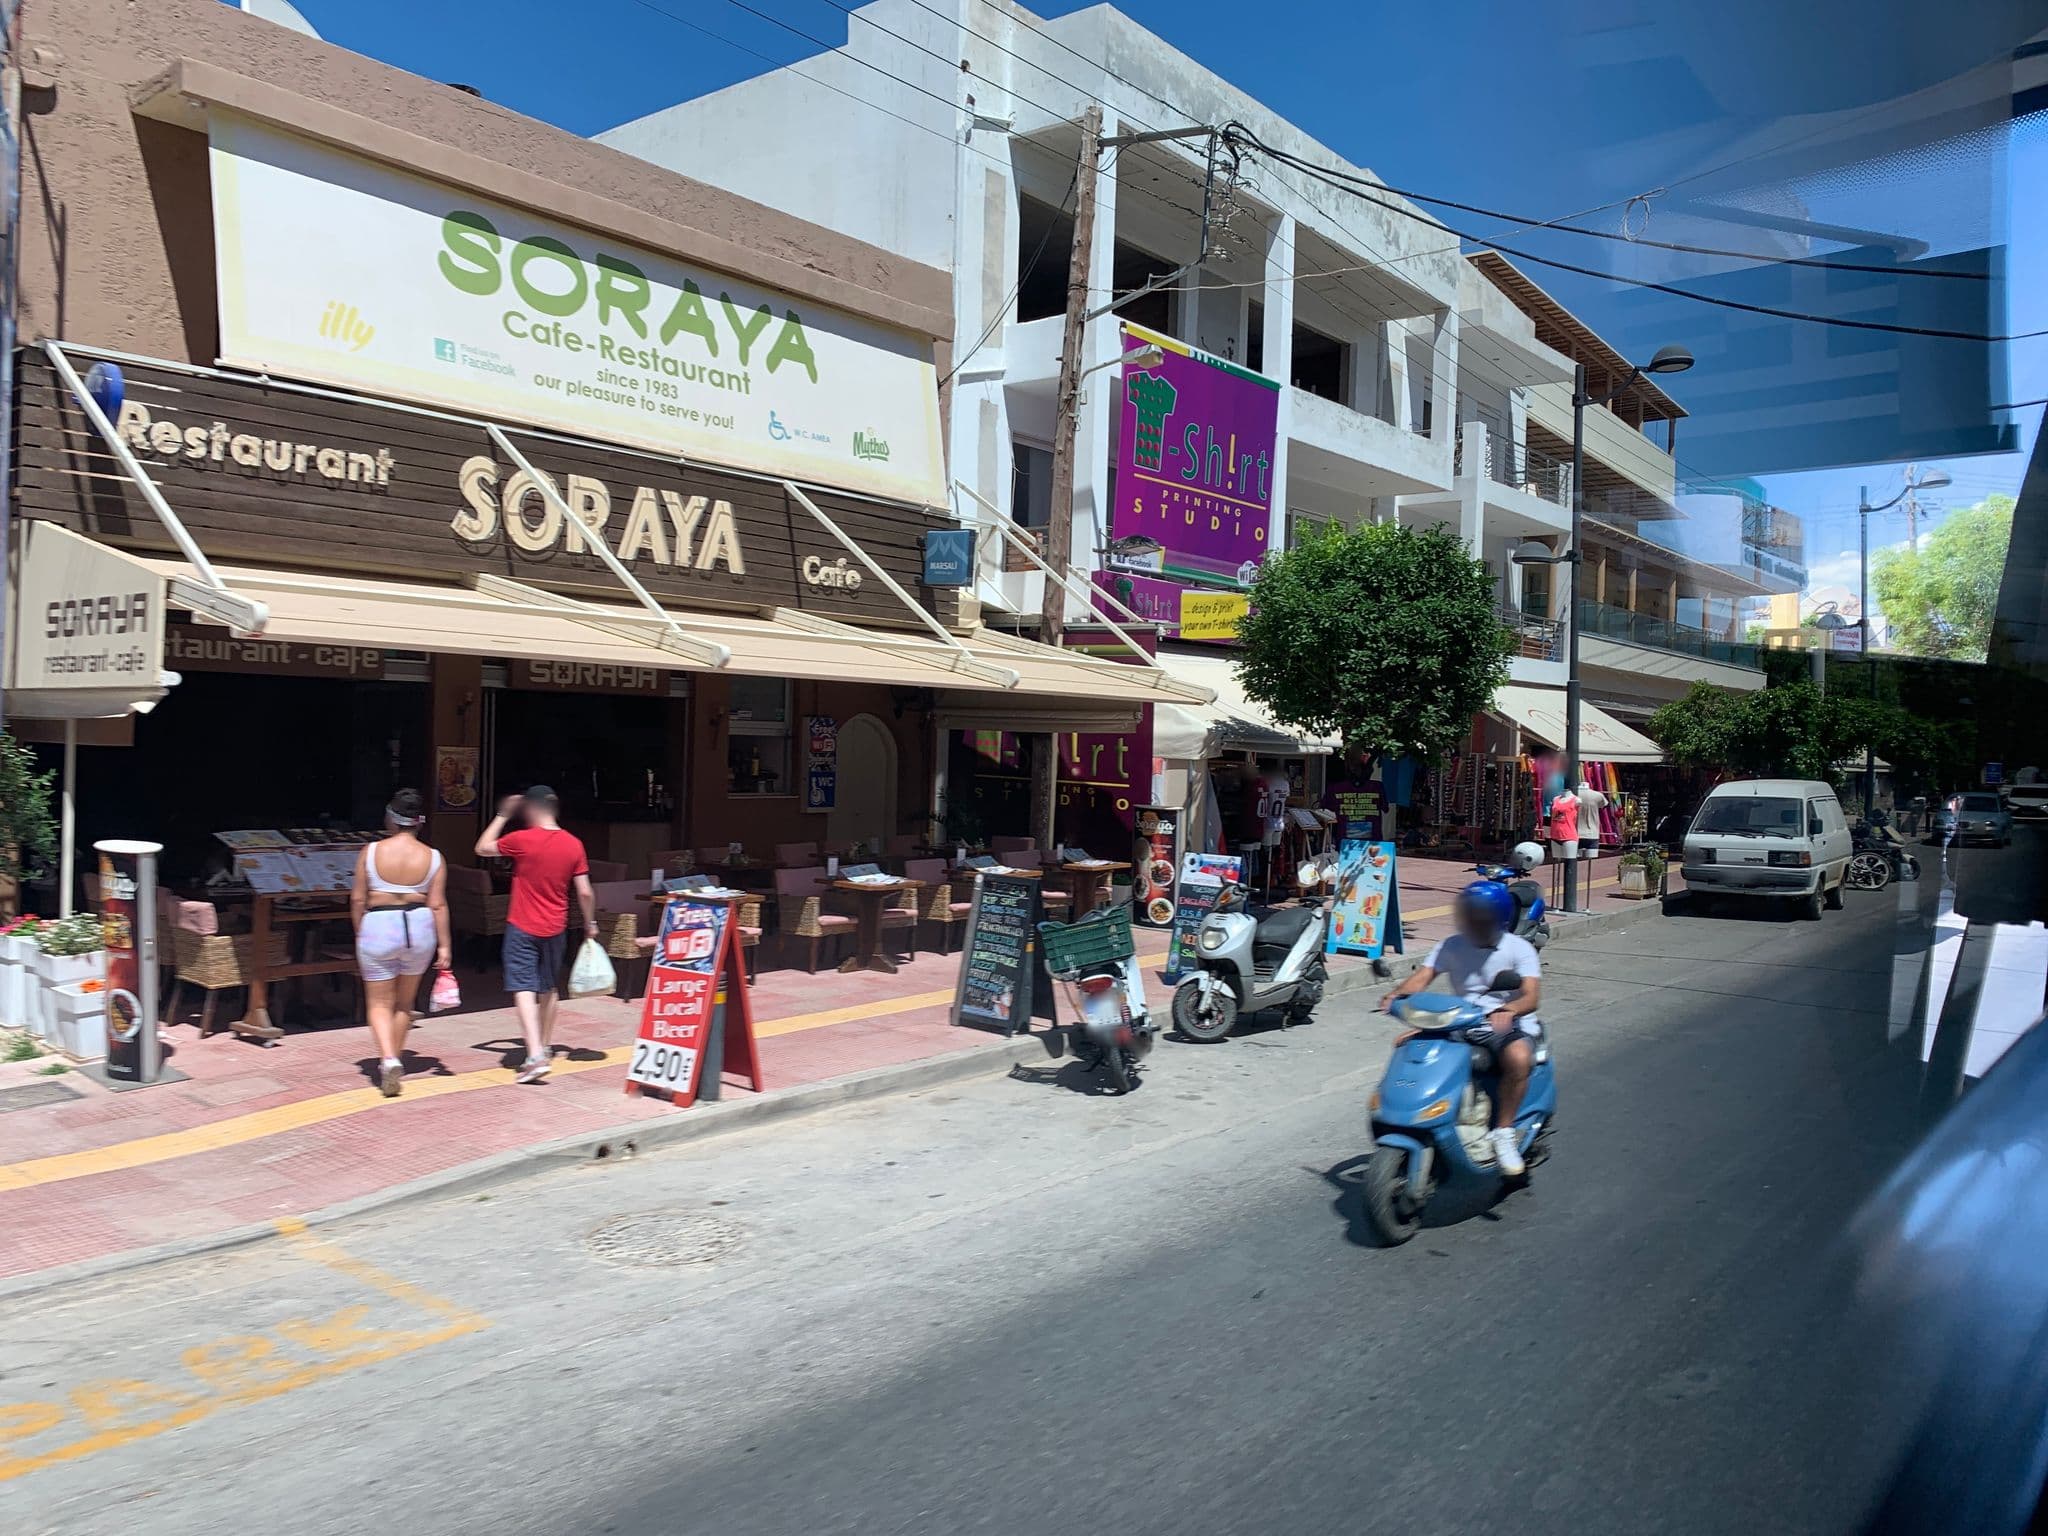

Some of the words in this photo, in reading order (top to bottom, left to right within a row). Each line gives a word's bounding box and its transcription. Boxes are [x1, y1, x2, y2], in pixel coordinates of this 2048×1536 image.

[437, 210, 818, 384] SORAYA
[319, 300, 374, 352] illy
[462, 354, 516, 376] Facebook
[502, 310, 751, 395] Cafe-Restaurant
[597, 368, 640, 390] since
[645, 378, 679, 399] 1983
[534, 373, 562, 390] our
[566, 380, 636, 408] pleasure
[640, 395, 656, 411] to
[660, 403, 699, 422] serve
[703, 412, 734, 429] you!
[118, 399, 395, 486] Restaurant
[853, 431, 890, 461] Mythos
[449, 455, 746, 576] SORAYA
[1162, 490, 1242, 517] PRINTING
[1133, 498, 1265, 542] STUDIO
[803, 555, 863, 591] Cafe
[46, 592, 150, 639] SORAYA
[44, 644, 146, 674] restaurant-cafe
[314, 644, 379, 674] cafe
[529, 659, 658, 690] SORAYA
[673, 907, 714, 926] Free
[652, 976, 707, 998] Large
[652, 998, 704, 1016] Local
[652, 1020, 699, 1040] Beer
